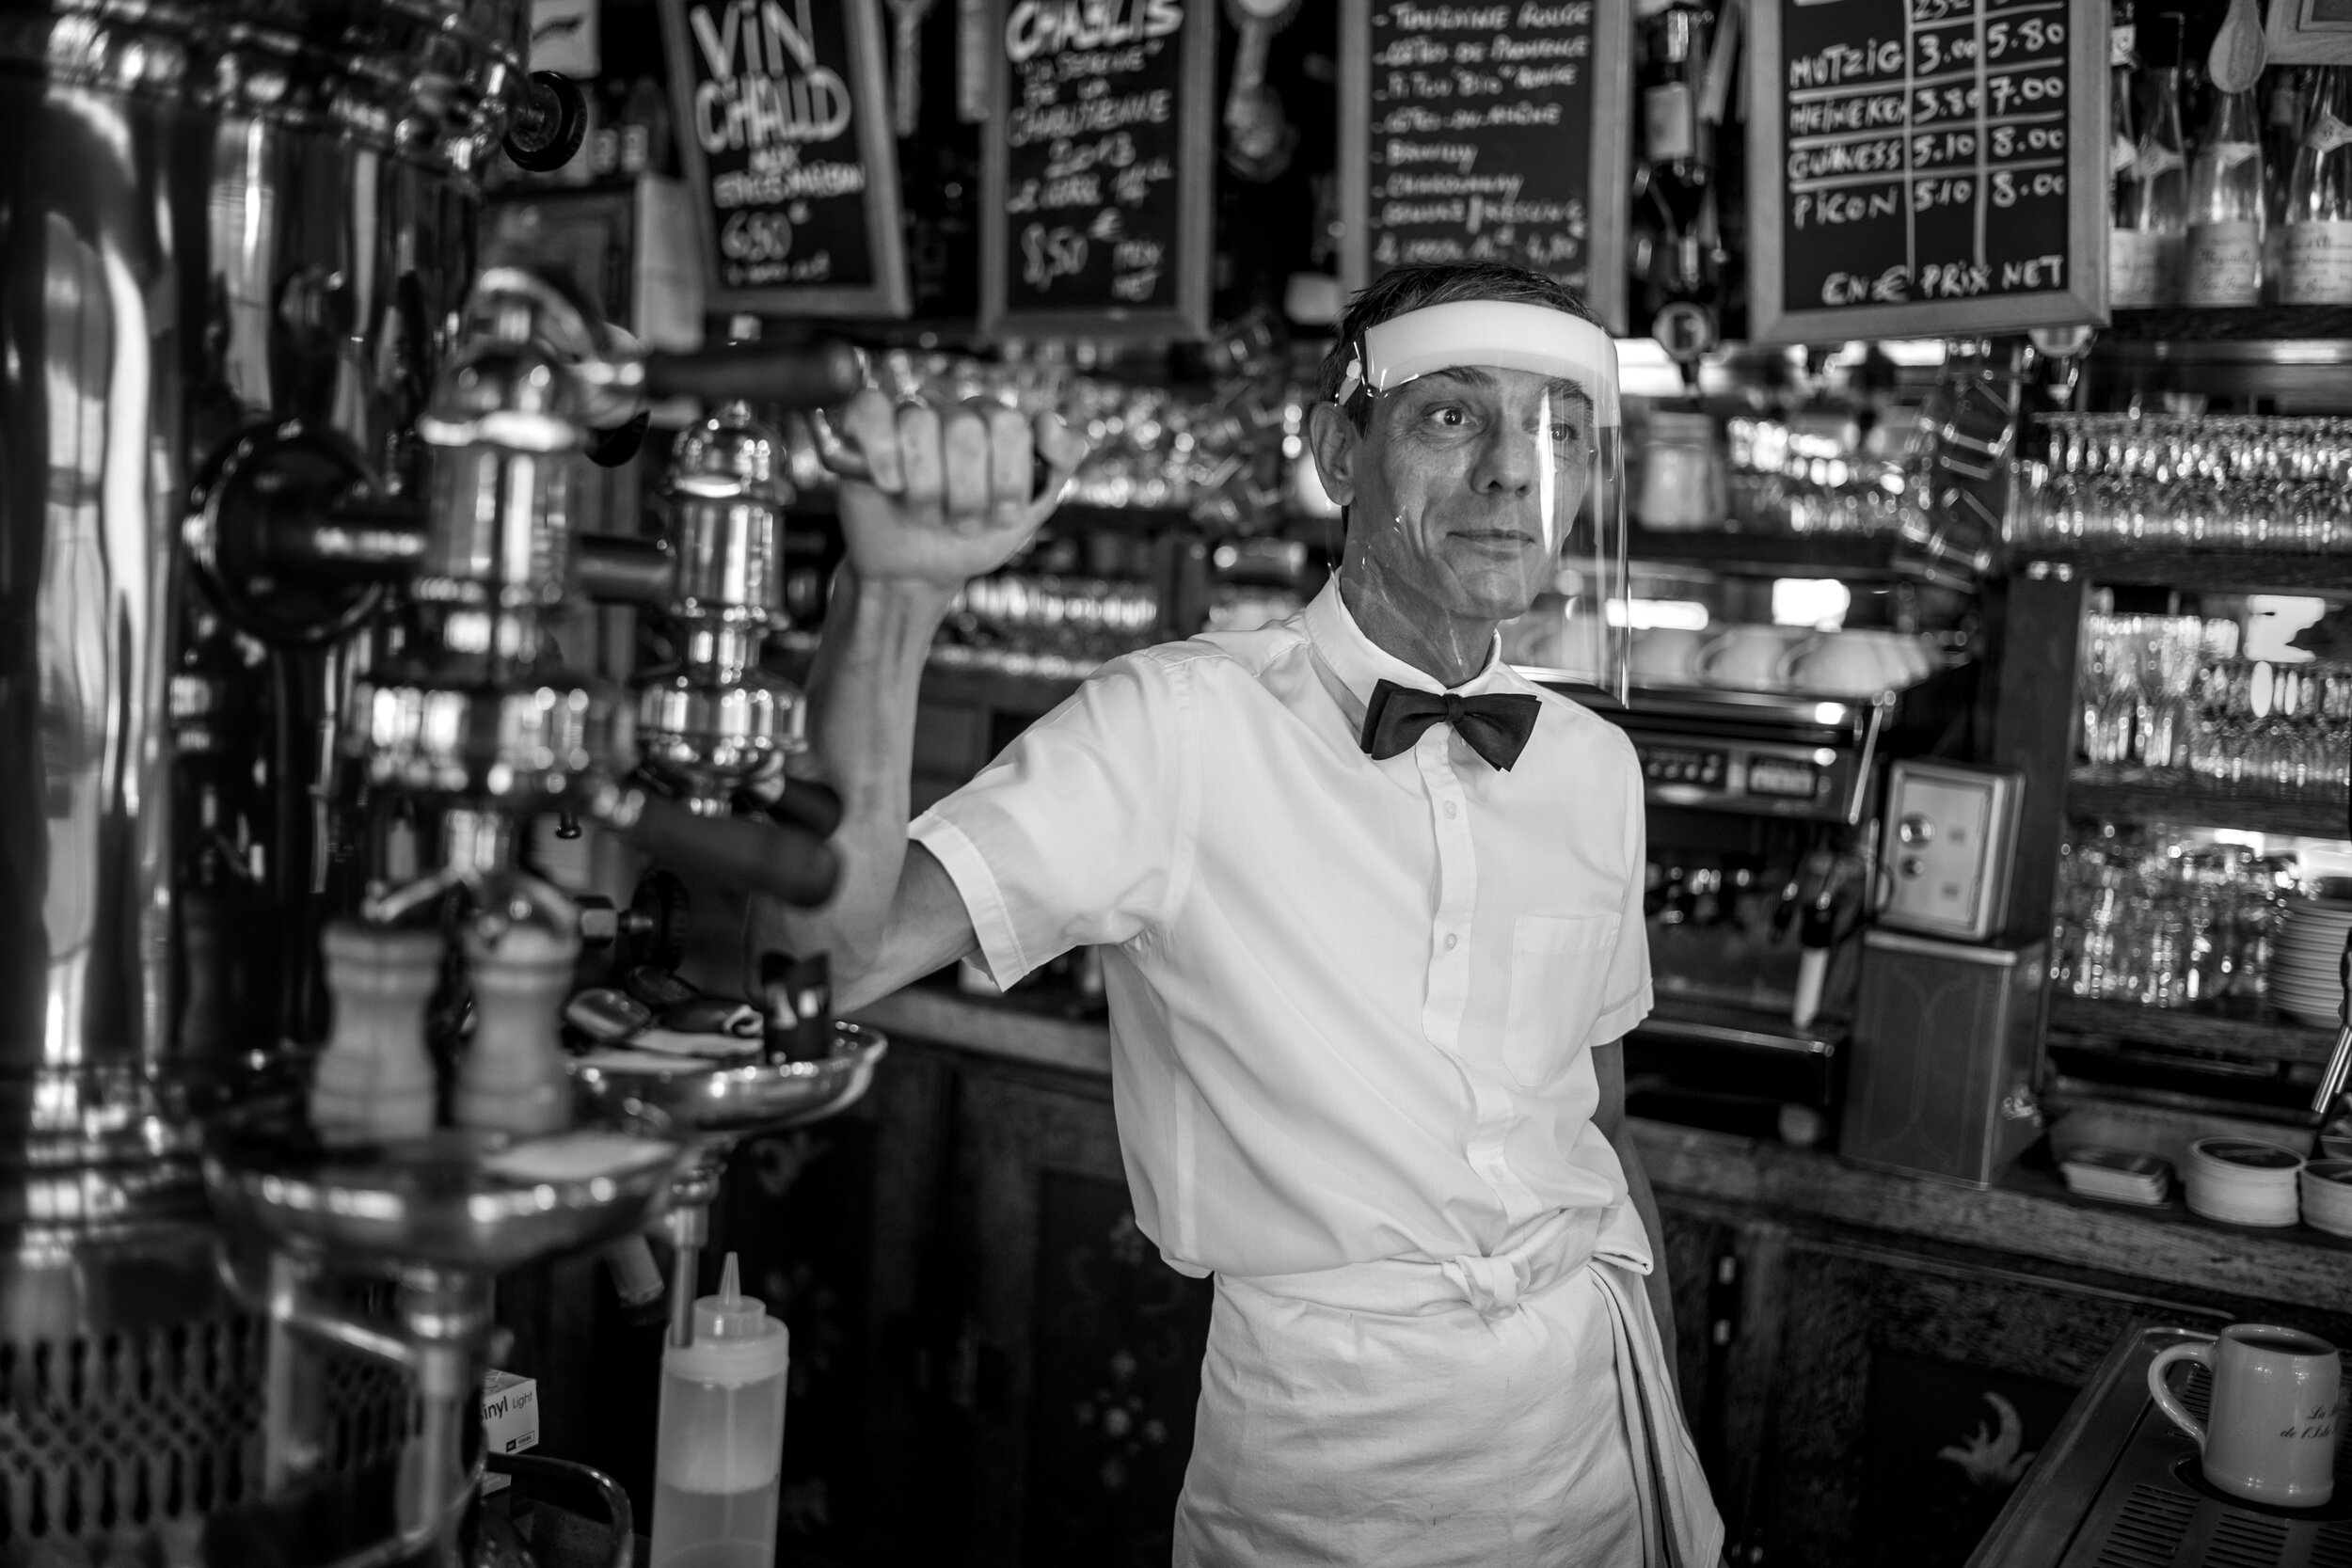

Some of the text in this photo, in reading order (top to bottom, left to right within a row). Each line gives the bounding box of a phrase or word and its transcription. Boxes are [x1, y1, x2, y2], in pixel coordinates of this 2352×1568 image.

[690, 0, 816, 80] VIN
[1987, 18, 2065, 58] 5.80
[1989, 76, 2064, 116] 7.00
[1913, 133, 1975, 166] 5.10
[1992, 125, 2065, 156] 8.00
[1792, 186, 1899, 230] PICON
[1992, 170, 2065, 207] 8.00
[1921, 260, 1992, 298] PRIX
[2003, 255, 2064, 290] NET
[512, 1391, 533, 1409] Light
[2280, 1426, 2297, 1438] de
